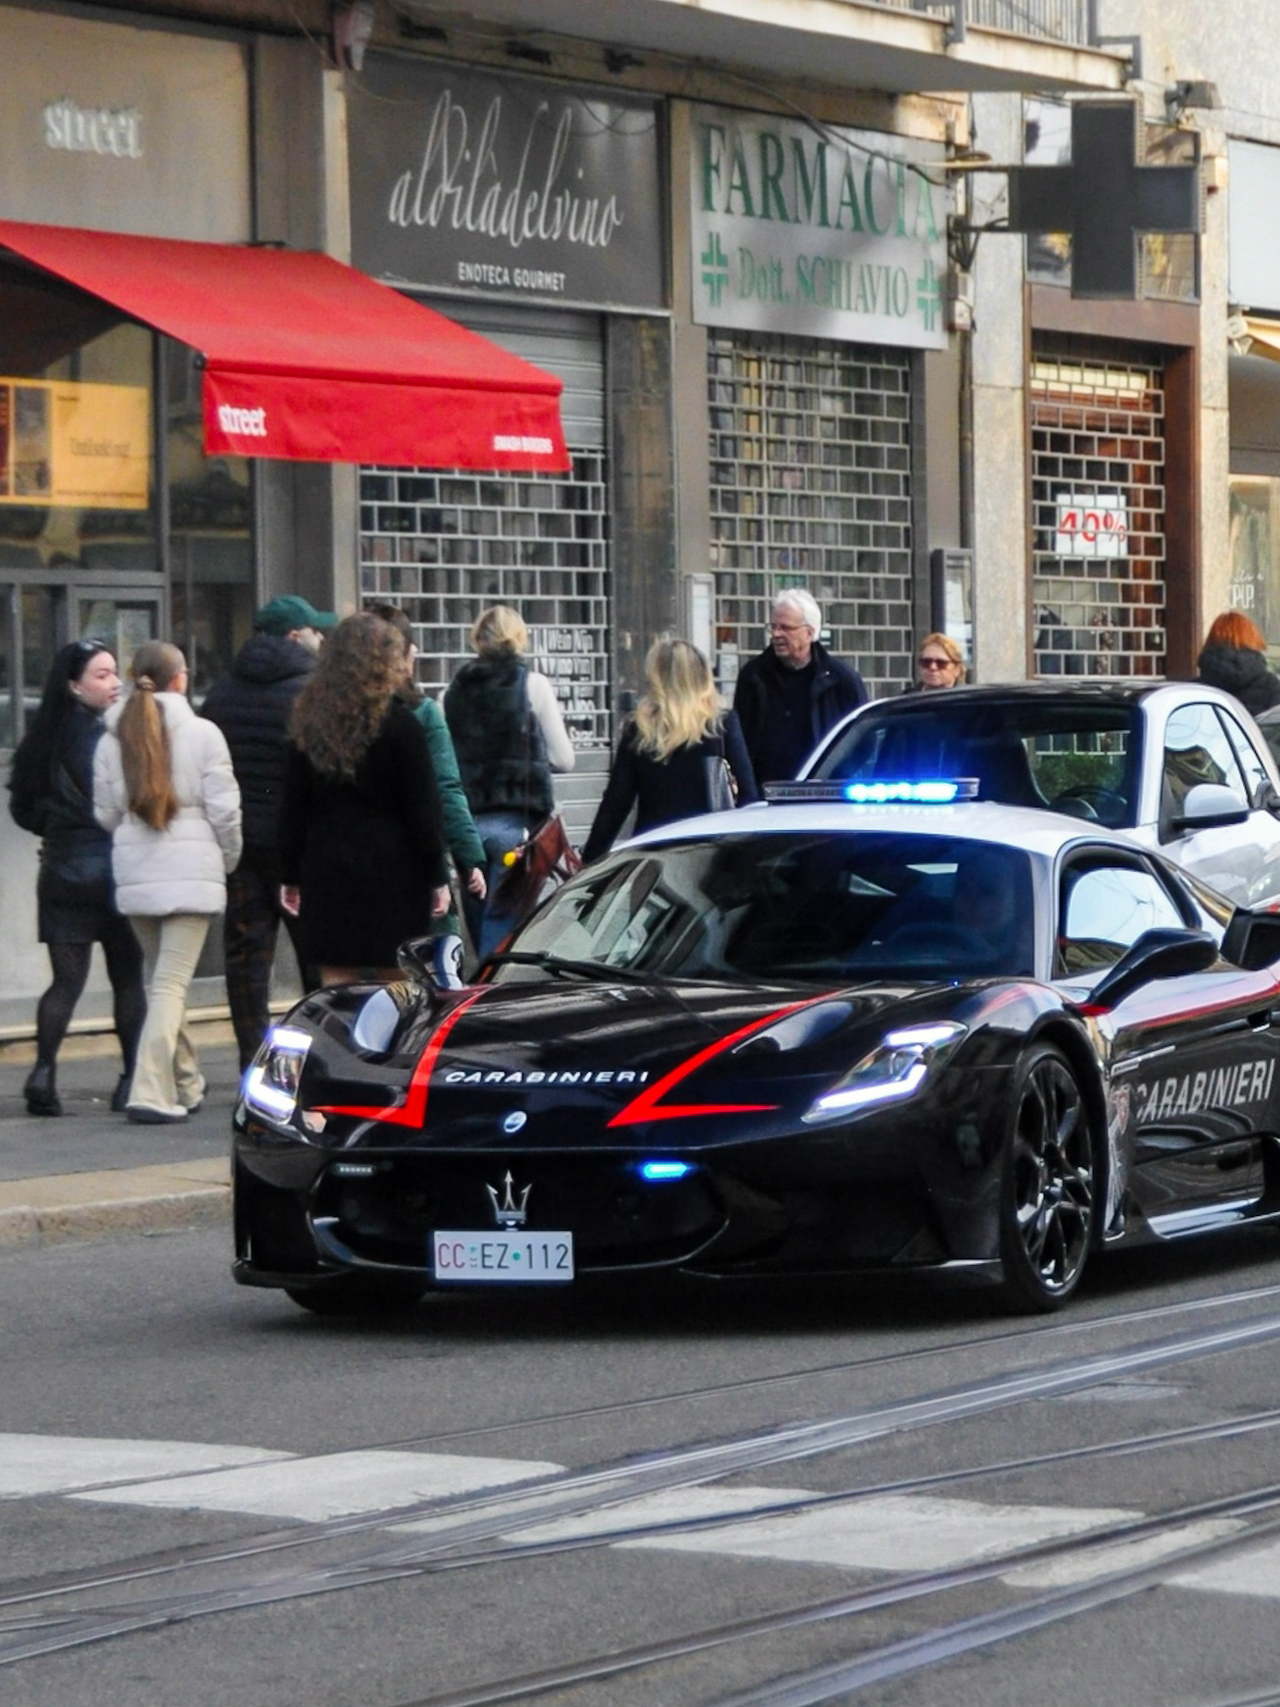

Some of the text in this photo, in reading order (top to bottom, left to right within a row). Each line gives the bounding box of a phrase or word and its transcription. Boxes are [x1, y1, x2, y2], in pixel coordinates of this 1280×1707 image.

[702, 123, 938, 242] FARMACIA
[458, 262, 565, 291] ENOTECA GOURMET
[797, 255, 909, 318] SCHIAVIO
[218, 404, 267, 437] street
[445, 1071, 649, 1083] CARABINIERI
[1136, 1058, 1275, 1124] CARABINIERI
